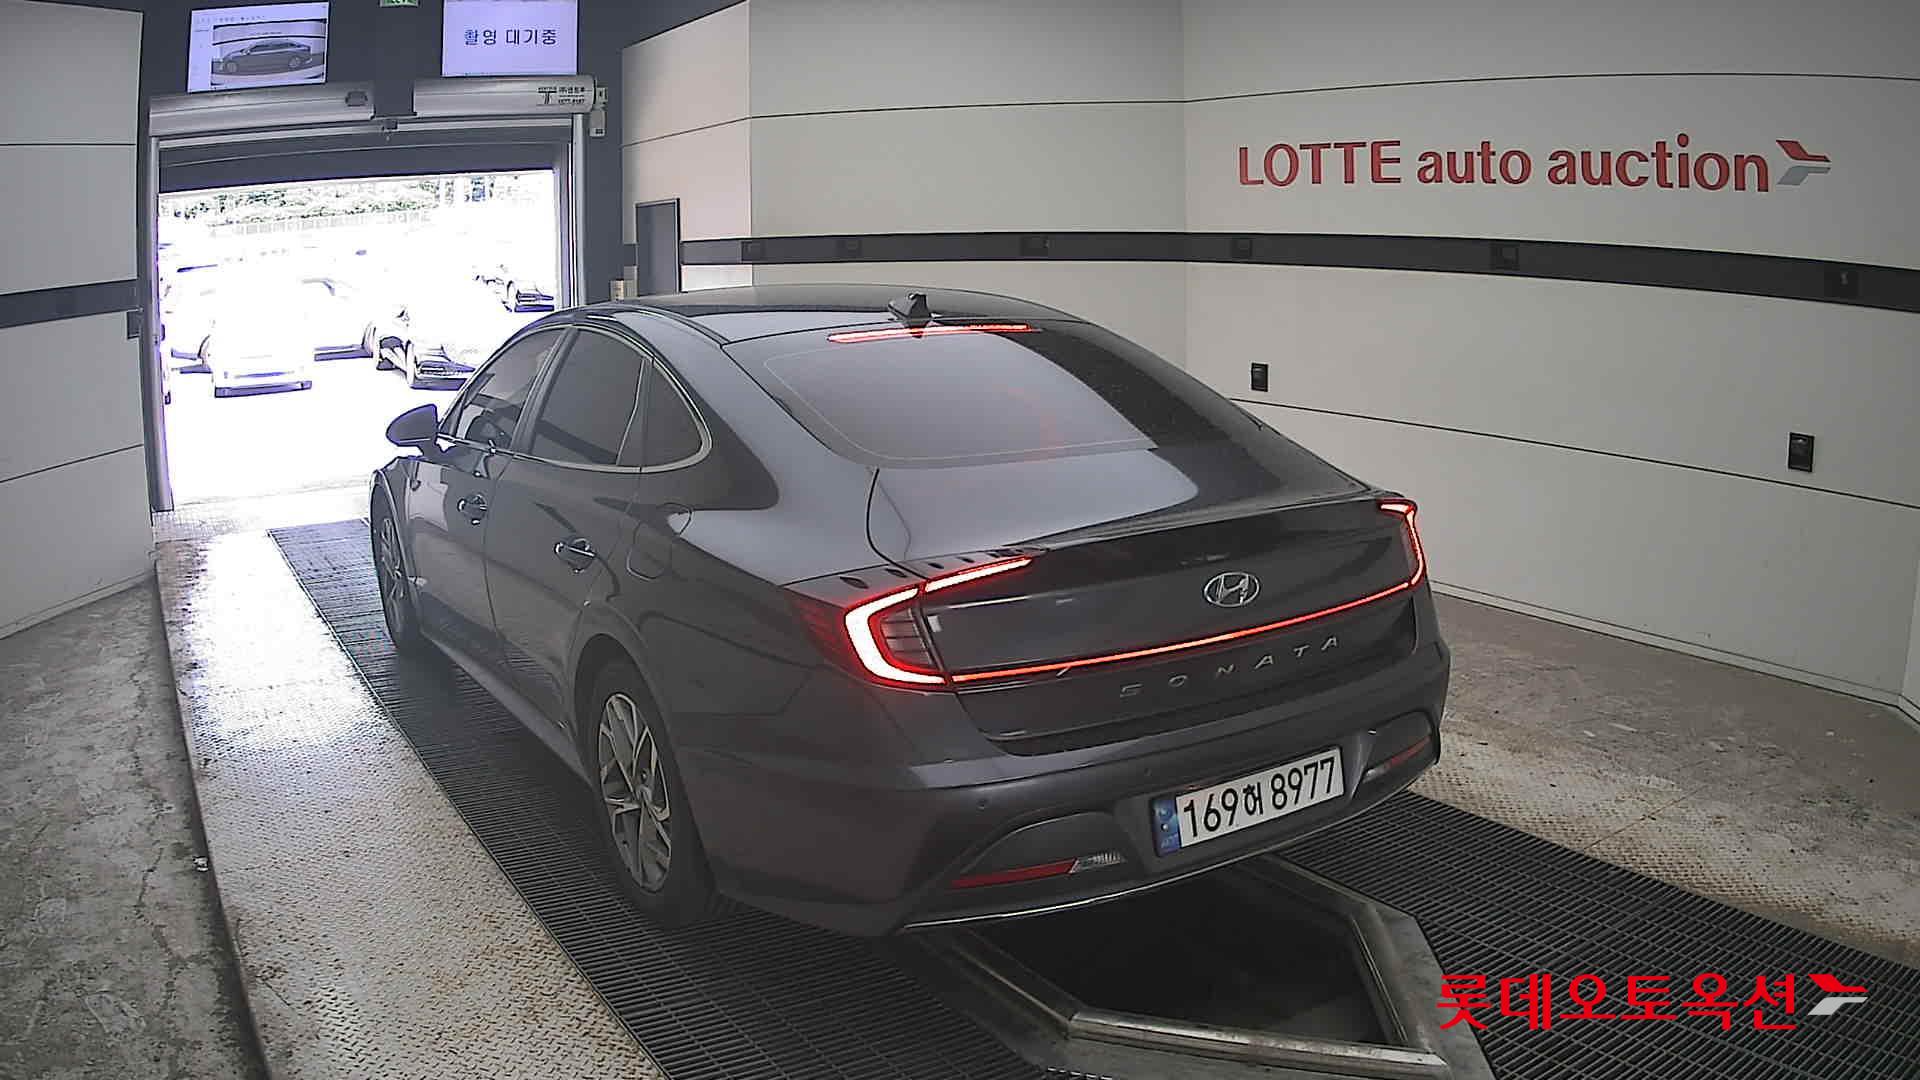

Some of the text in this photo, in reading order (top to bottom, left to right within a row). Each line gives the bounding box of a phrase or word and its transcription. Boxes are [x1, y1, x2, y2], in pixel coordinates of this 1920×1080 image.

[505, 29, 557, 46] 대기중
[1239, 133, 1770, 193] LOTTE auto auction
[1119, 636, 1339, 698] SONATA
[1183, 756, 1335, 838] 169허 8977
